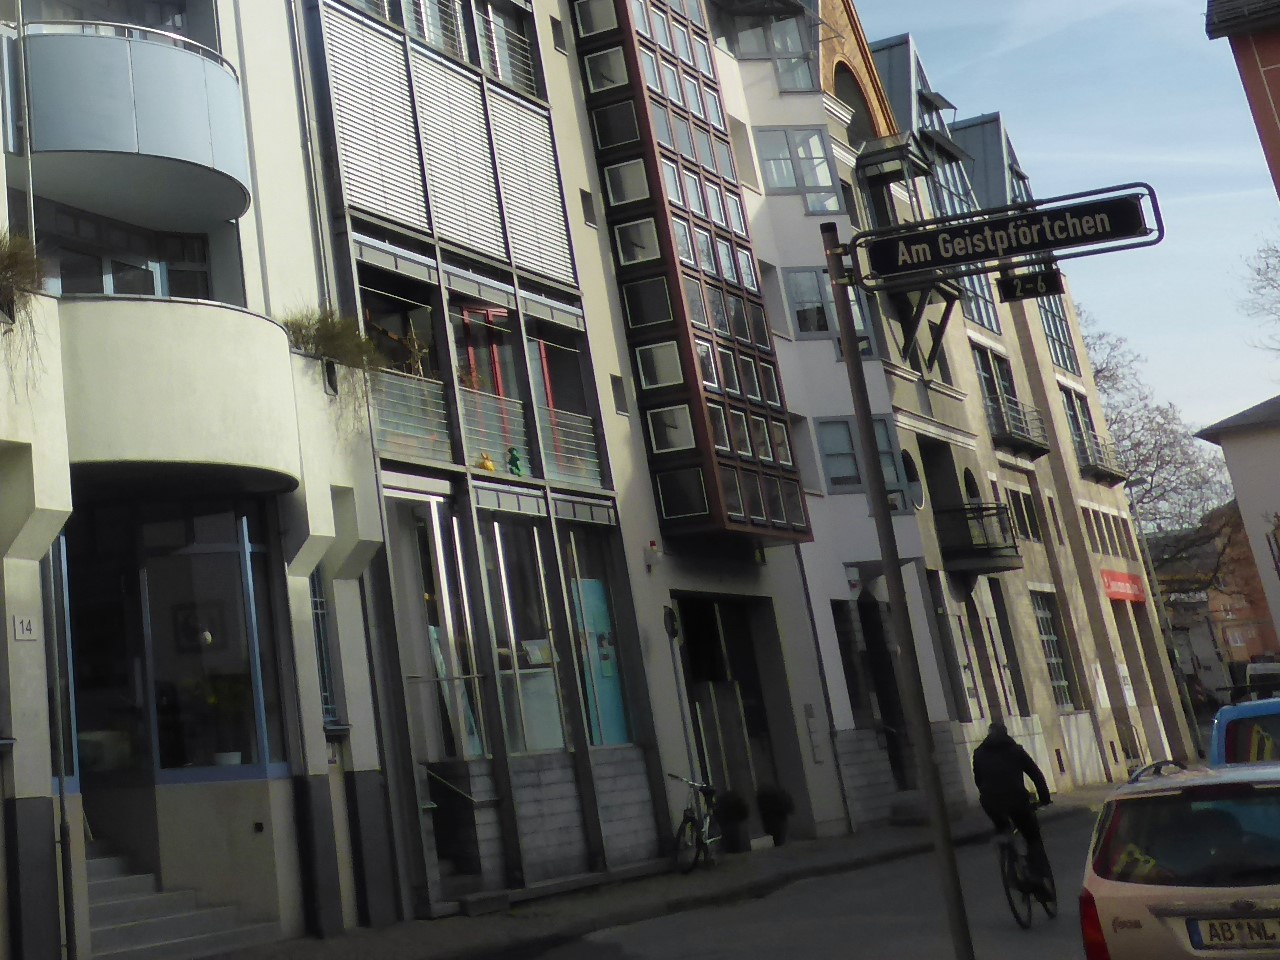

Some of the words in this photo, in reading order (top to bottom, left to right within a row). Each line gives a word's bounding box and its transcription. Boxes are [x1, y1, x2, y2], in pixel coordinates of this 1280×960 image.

[898, 240, 932, 266] Am
[939, 211, 1111, 257] Geistpförtchen
[19, 619, 32, 634] 14
